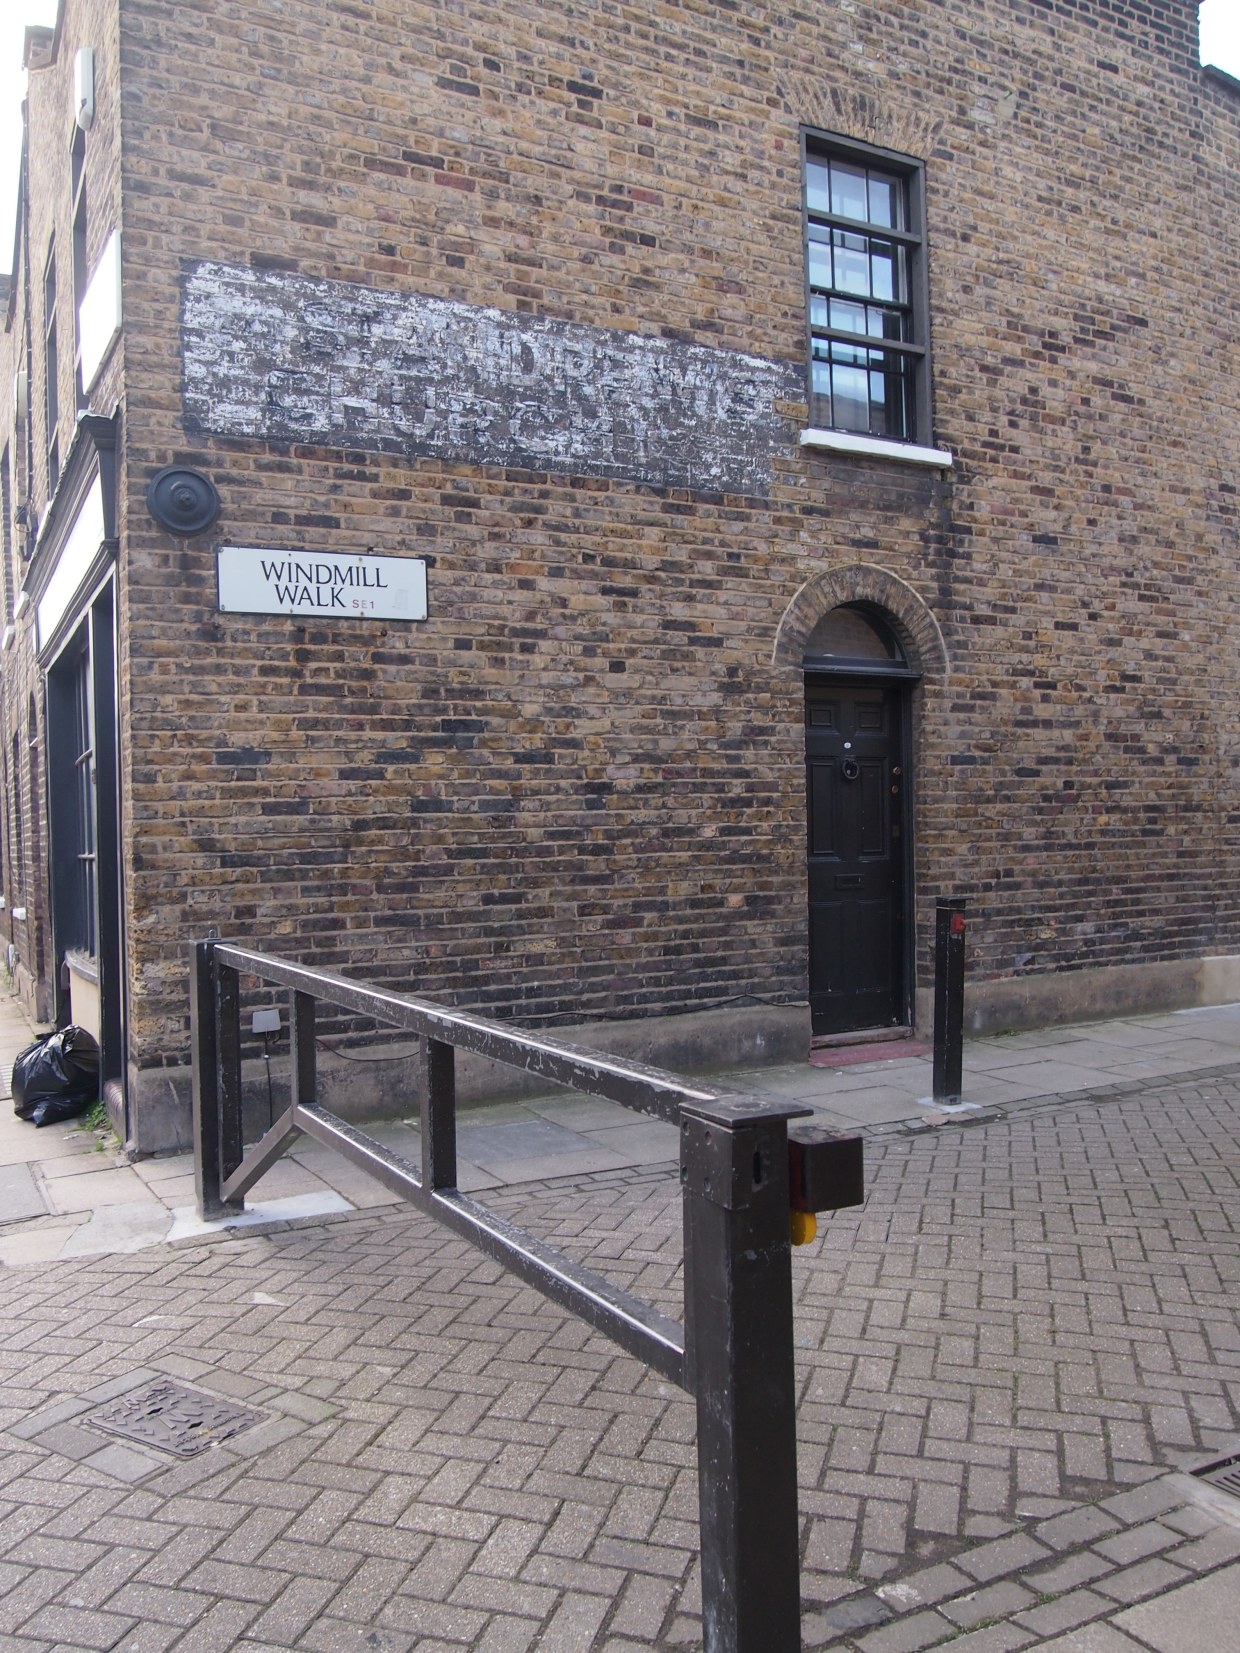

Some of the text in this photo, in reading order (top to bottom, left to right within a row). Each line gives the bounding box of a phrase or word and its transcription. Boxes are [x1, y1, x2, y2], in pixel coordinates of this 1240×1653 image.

[260, 560, 388, 588] WINDMILL
[274, 584, 375, 609] WALK SE1
